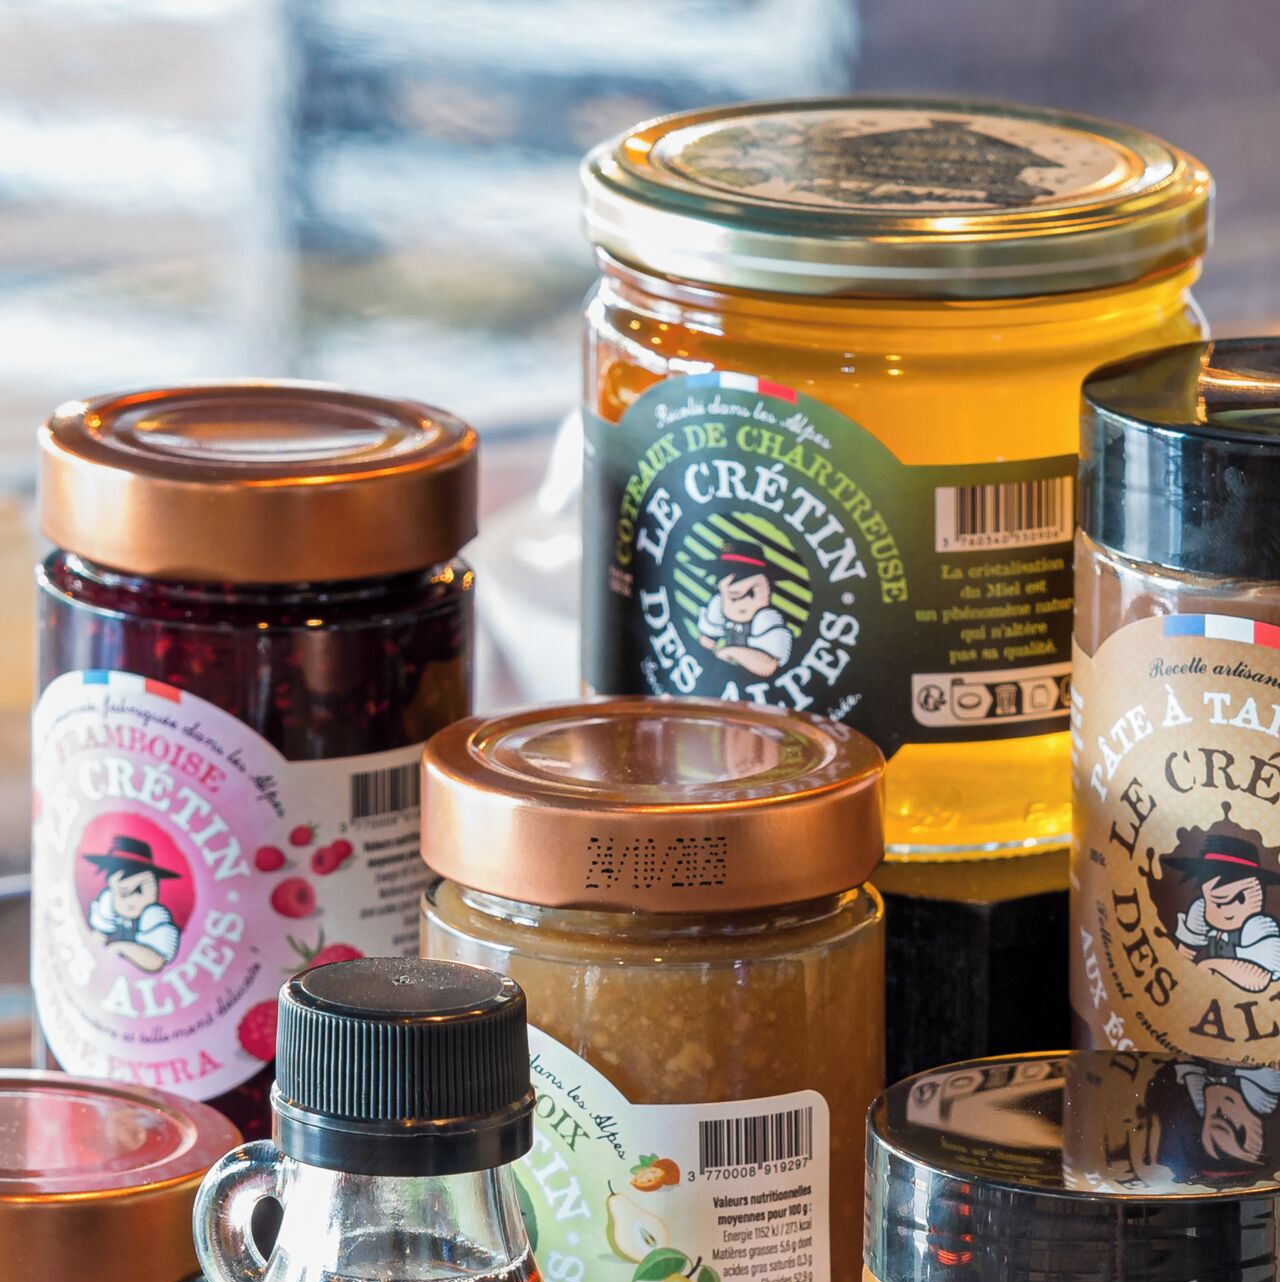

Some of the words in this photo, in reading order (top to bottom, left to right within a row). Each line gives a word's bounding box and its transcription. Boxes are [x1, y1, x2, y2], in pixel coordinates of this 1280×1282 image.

[616, 432, 682, 565] COTEAUX
[682, 422, 727, 450] DE
[736, 425, 908, 603] CHARTREUSE
[637, 487, 683, 566] LE
[684, 459, 867, 583] CRÉTIN
[986, 581, 1020, 598] Miel
[1025, 580, 1047, 593] est
[639, 585, 703, 693] DES
[960, 626, 987, 644] qui
[1149, 657, 1207, 679] Recette
[56, 723, 228, 793] FRAMBOISE
[1090, 704, 1154, 803] PÂTE
[1161, 684, 1193, 727] À
[77, 756, 251, 880] CRÉTIN
[1109, 778, 1157, 860] LE
[103, 909, 245, 1018] ALPES
[1080, 929, 1108, 1008] AUX
[1111, 888, 1178, 1007] DES
[567, 1085, 588, 1111] les
[589, 1112, 627, 1160] Alpes
[688, 1171, 696, 1182] 3
[706, 1166, 757, 1181] 770008
[765, 1157, 809, 1176] 919297
[713, 1193, 749, 1209] Valeurs
[750, 1185, 812, 1205] nutritionnelles
[712, 1247, 748, 1261] Matières
[749, 1243, 778, 1260] grasses
[718, 1210, 766, 1227] moyennes
[768, 1206, 788, 1223] pour
[723, 1229, 753, 1244] Energie
[723, 1263, 749, 1277] acides
[751, 1263, 767, 1277] gras
